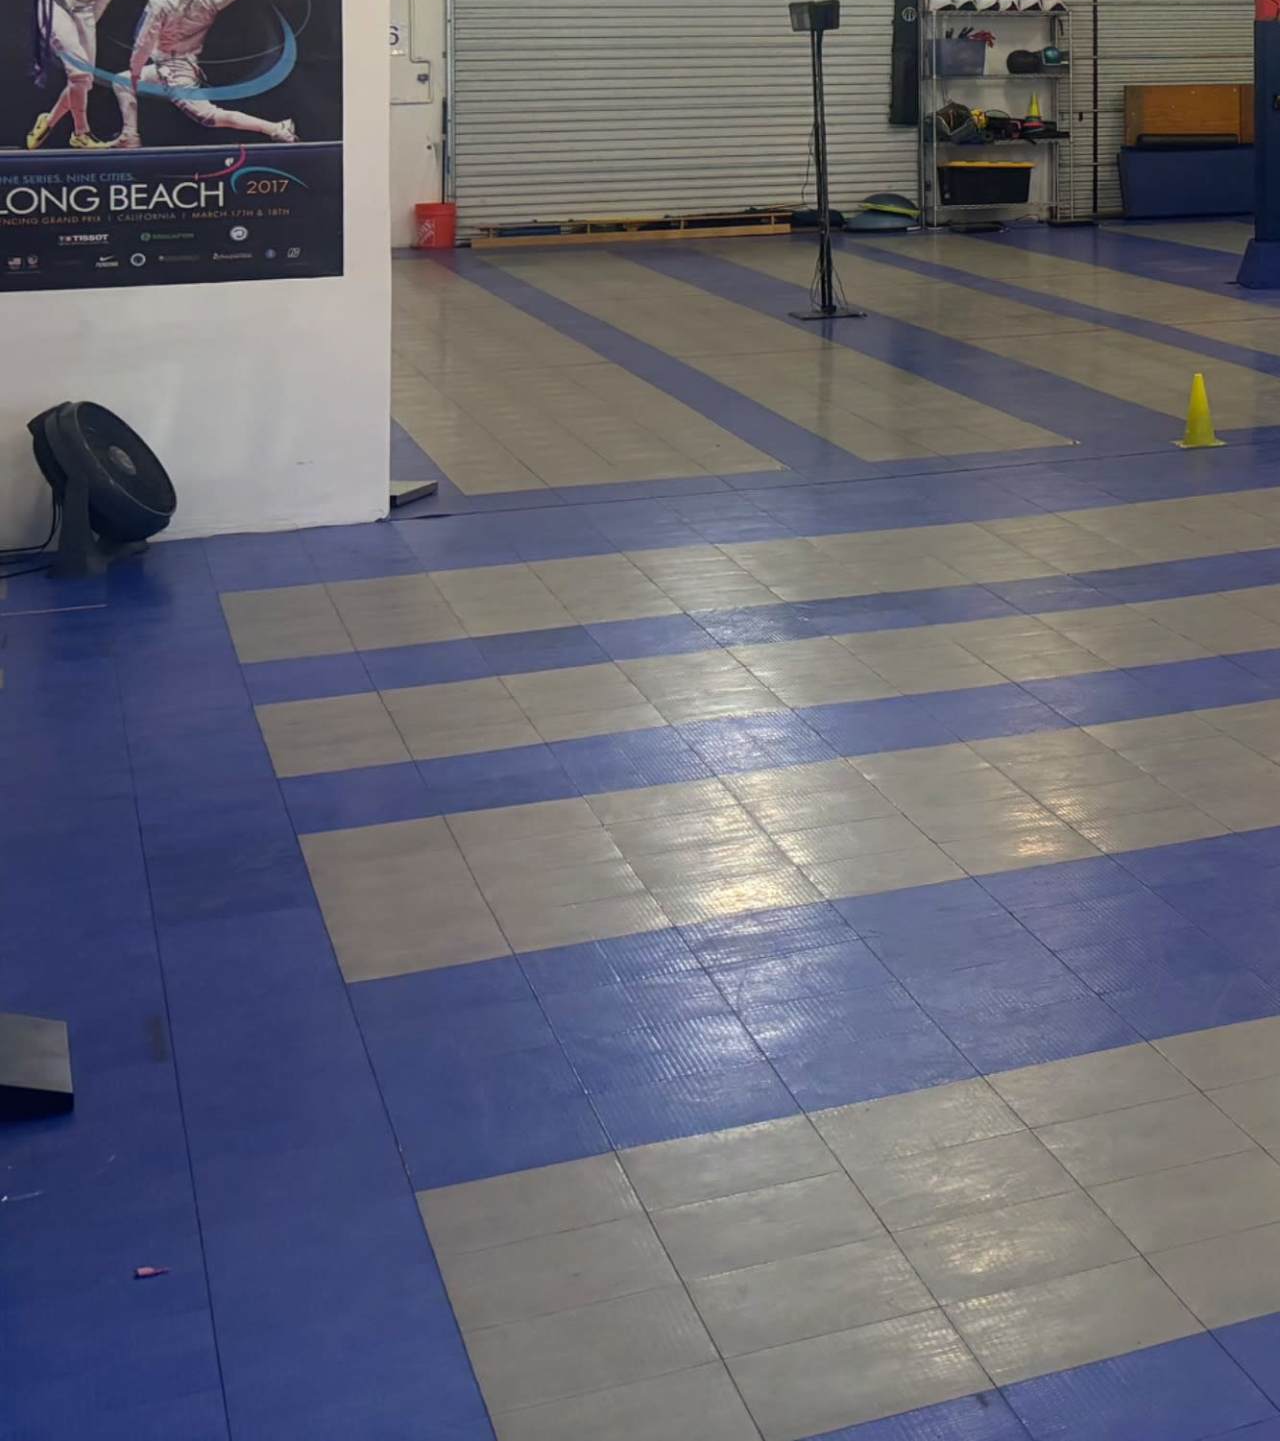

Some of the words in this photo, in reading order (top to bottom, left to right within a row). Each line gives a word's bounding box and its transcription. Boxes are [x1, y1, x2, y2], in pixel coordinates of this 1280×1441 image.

[66, 173, 97, 183] NINE
[246, 180, 289, 194] 2017
[109, 181, 224, 212] BEACH
[41, 215, 79, 225] GRAND
[117, 212, 176, 222] CALIFORNIA
[192, 211, 227, 219] MARCH
